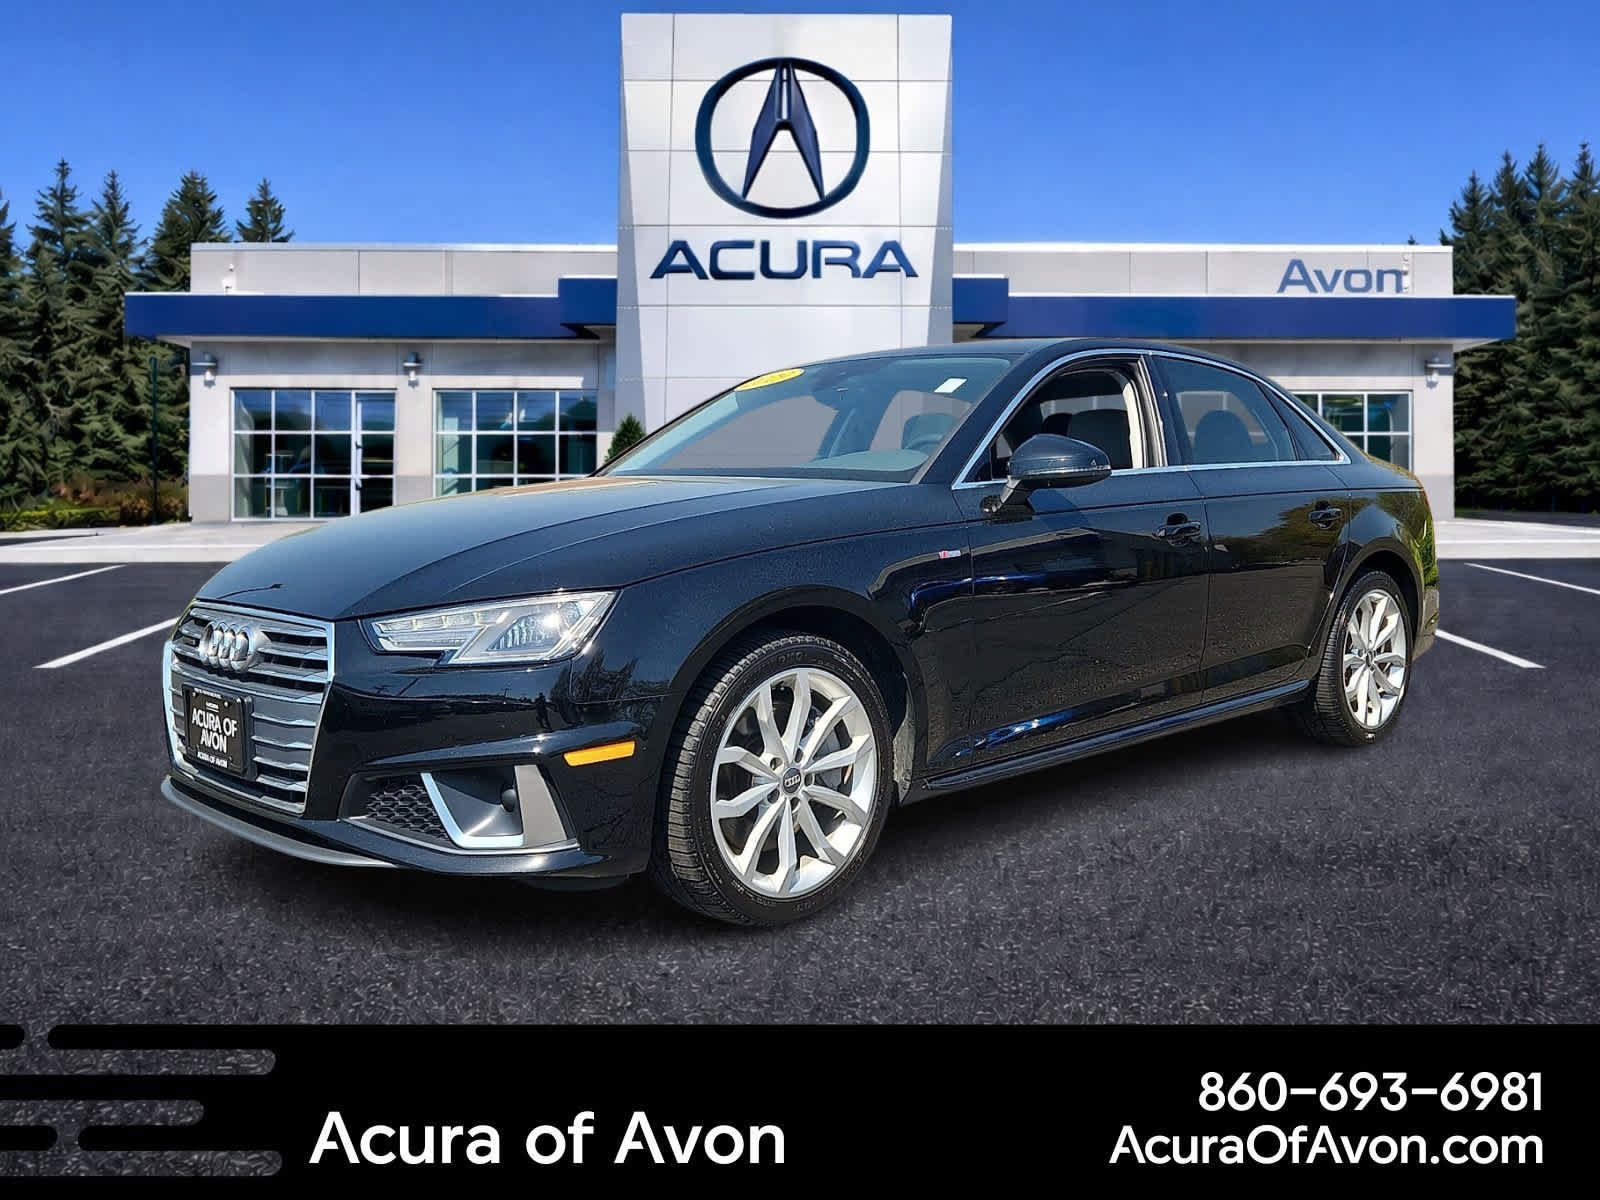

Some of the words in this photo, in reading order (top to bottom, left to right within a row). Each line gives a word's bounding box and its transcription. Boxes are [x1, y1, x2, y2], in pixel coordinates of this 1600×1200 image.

[650, 240, 919, 280] ACURA
[1277, 259, 1403, 293] Avon
[192, 707, 221, 733] ACURA
[223, 717, 237, 737] OF
[200, 728, 227, 753] AVON
